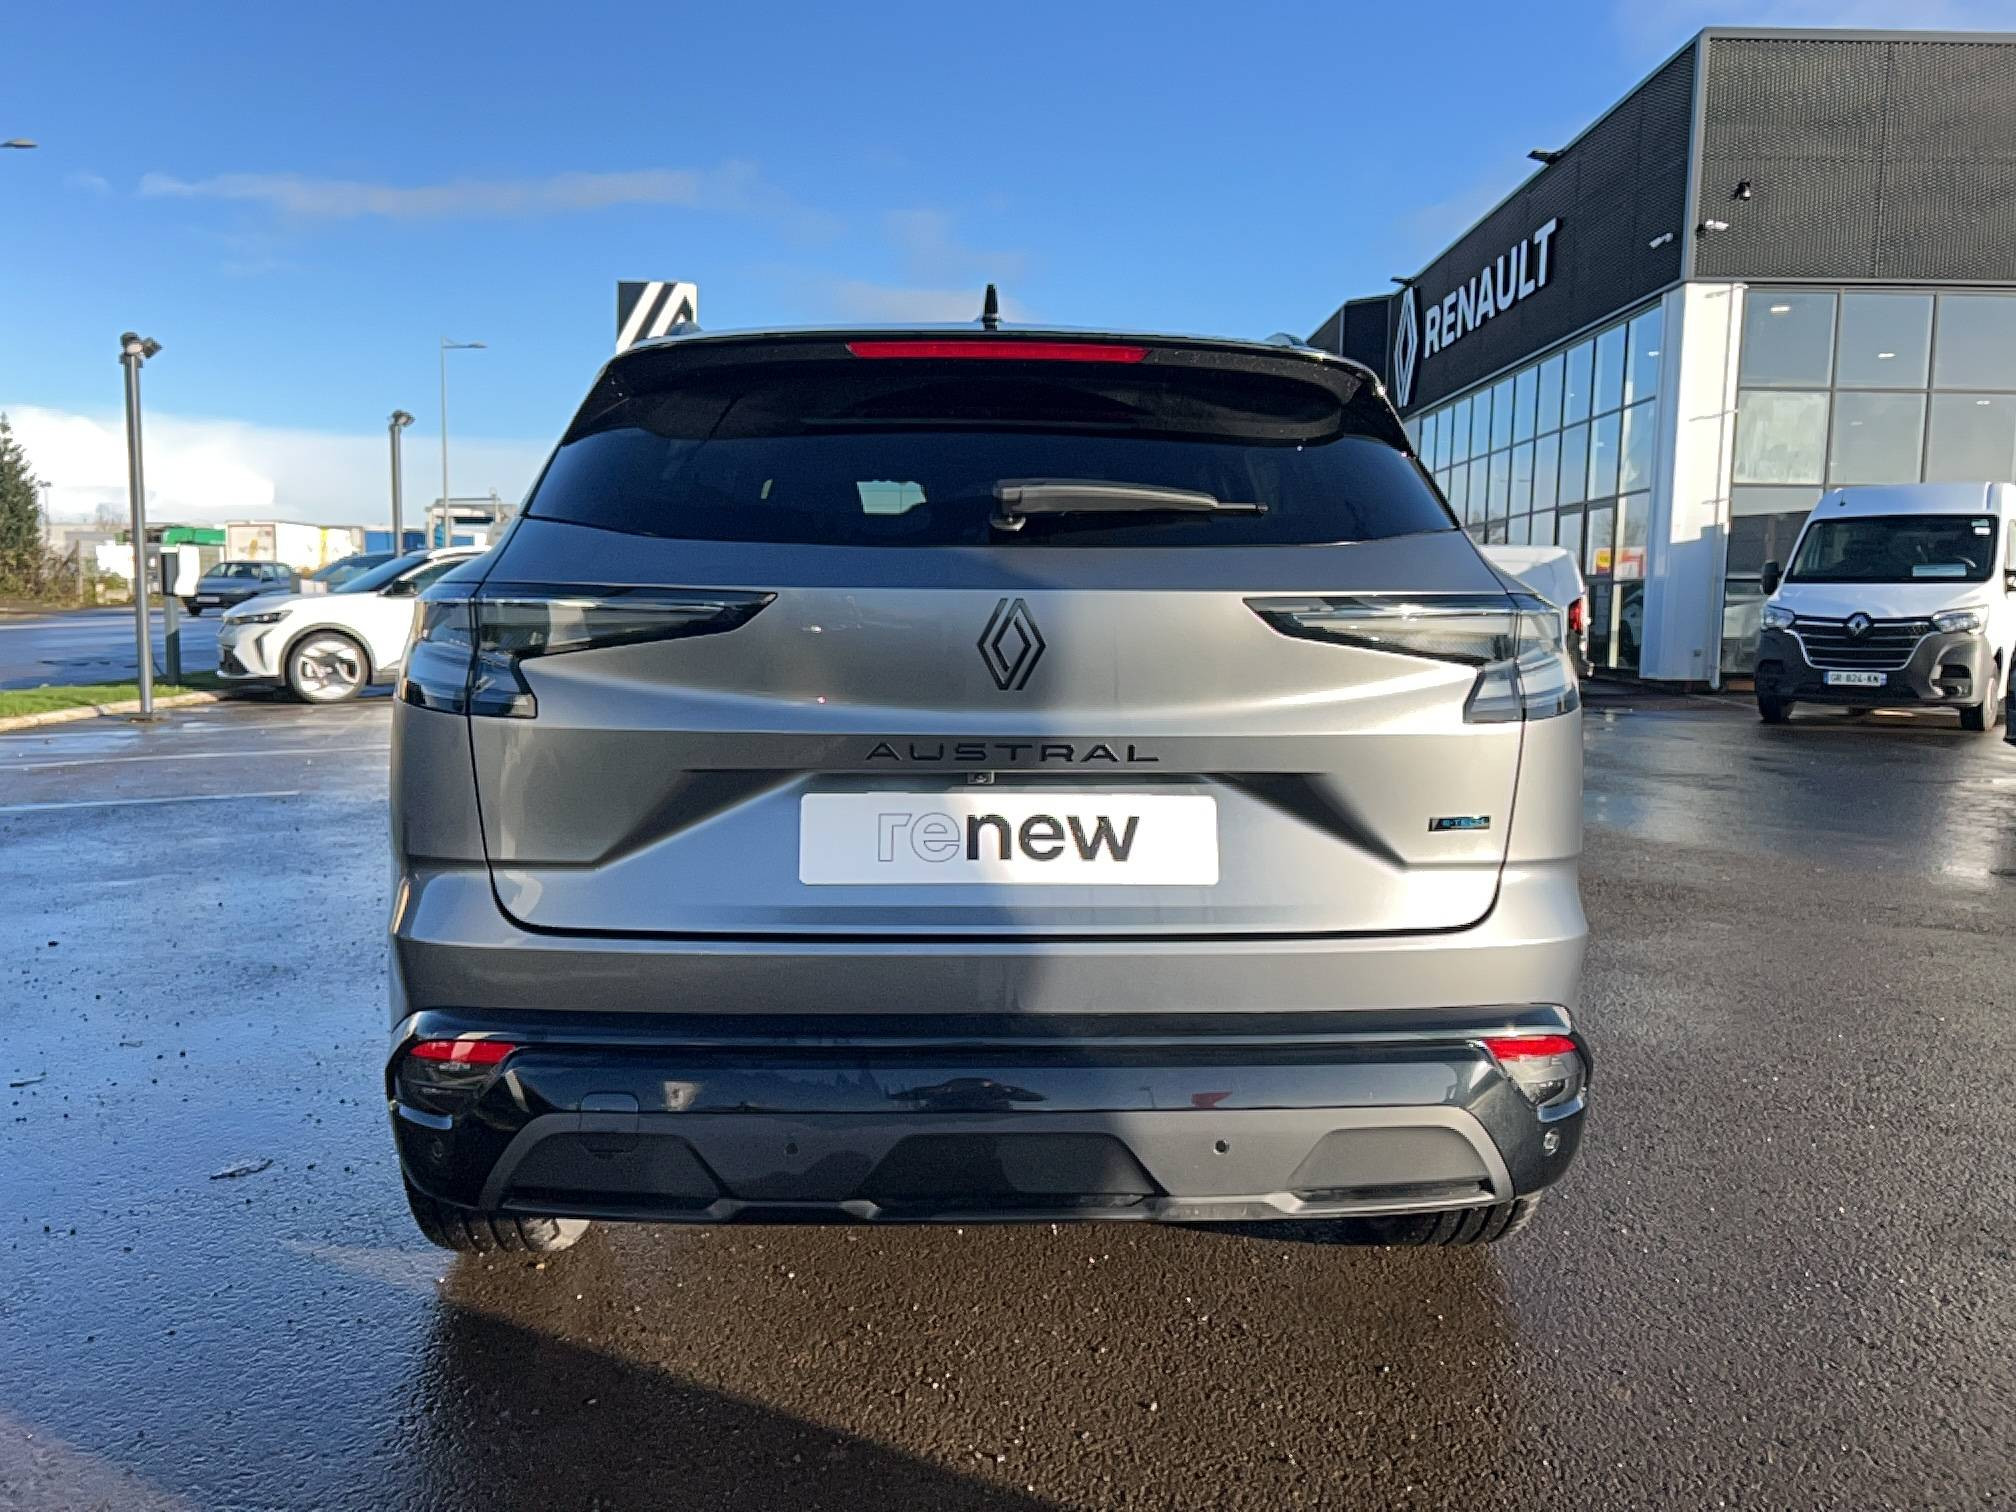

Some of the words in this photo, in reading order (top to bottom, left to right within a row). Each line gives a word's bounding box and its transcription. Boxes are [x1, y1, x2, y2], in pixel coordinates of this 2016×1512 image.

[1425, 218, 1557, 358] RENAULT
[866, 743, 1160, 762] AUSTRAL
[877, 813, 1140, 863] renew
